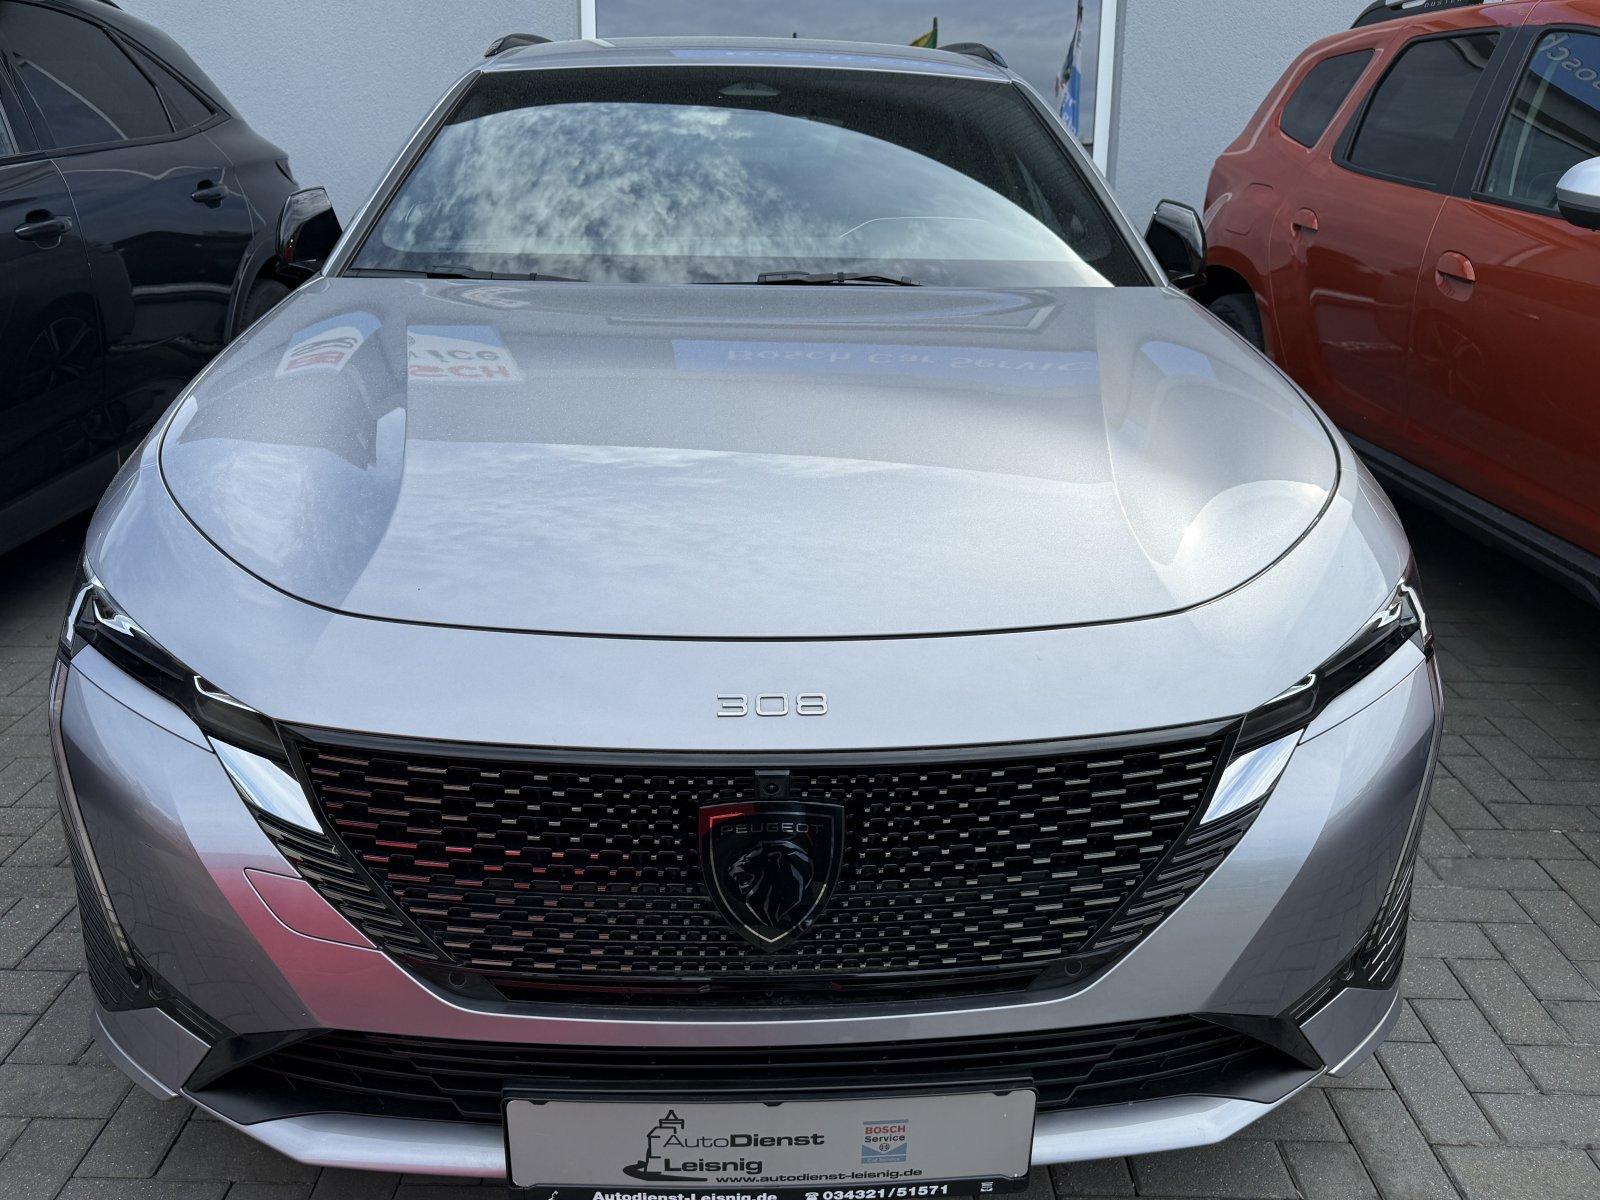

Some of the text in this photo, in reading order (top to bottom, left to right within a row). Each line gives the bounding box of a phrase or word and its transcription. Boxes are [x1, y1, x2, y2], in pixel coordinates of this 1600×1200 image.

[716, 693, 828, 717] 308
[721, 822, 824, 836] PEUGEOT
[865, 1125, 906, 1134] BOSCH
[663, 1133, 825, 1148] AutoDienst
[864, 1134, 905, 1142] Service
[664, 1158, 763, 1174] Leisnig
[716, 1168, 923, 1182] www.autodienst-leisnig.de
[822, 1185, 948, 1200] 034321/51571
